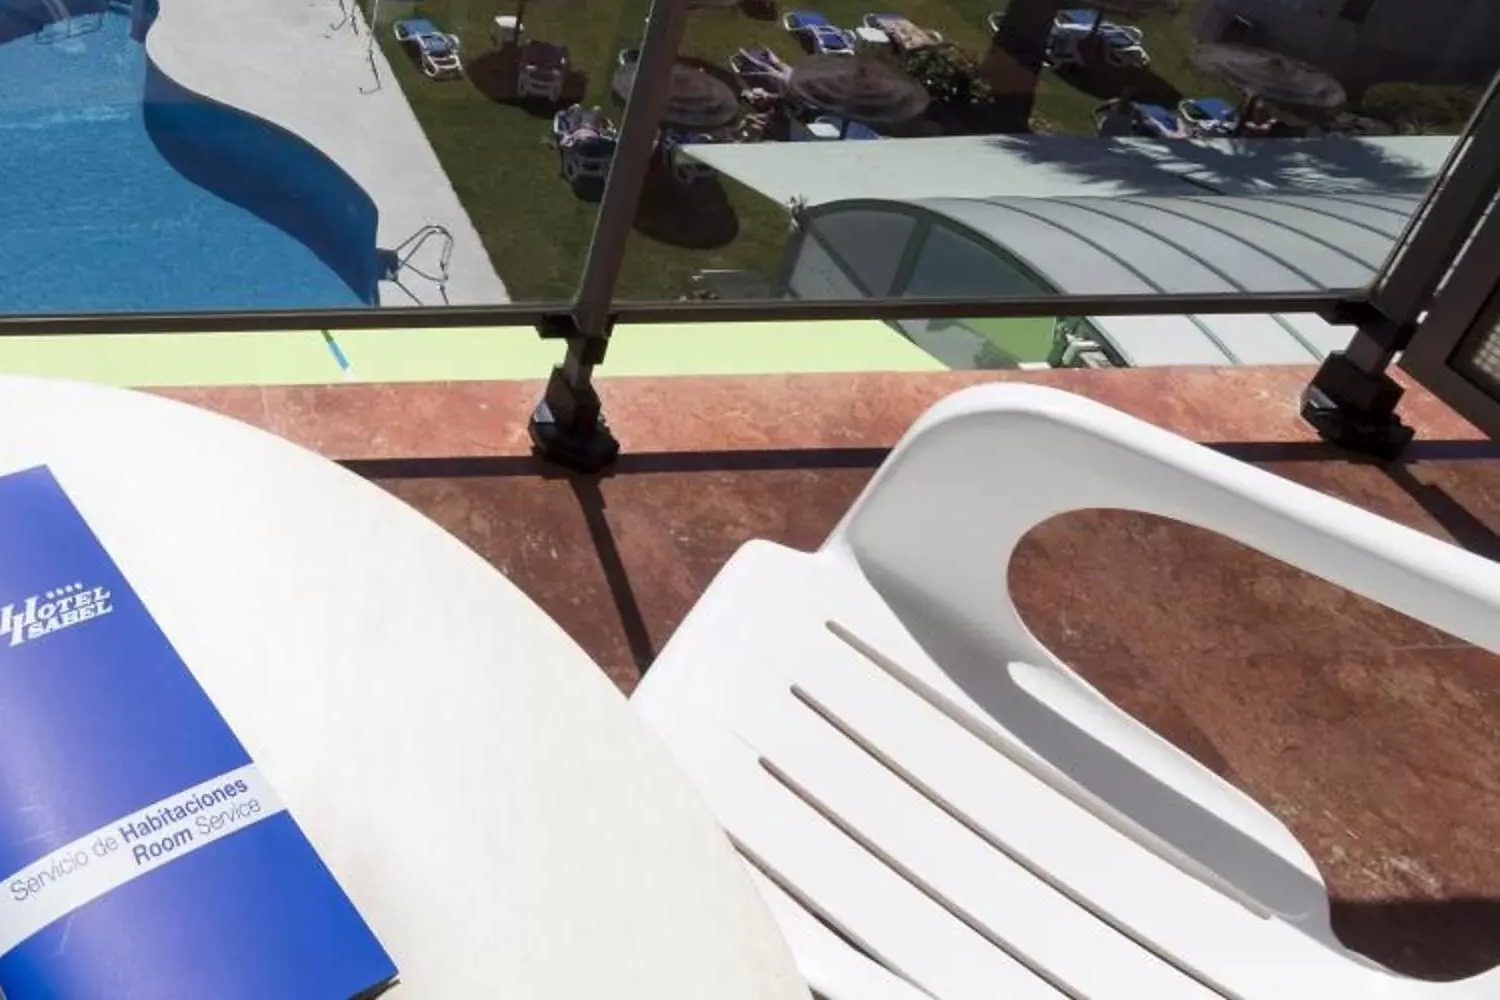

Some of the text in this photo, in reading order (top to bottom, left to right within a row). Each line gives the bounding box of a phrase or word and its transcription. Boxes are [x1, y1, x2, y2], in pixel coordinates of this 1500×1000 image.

[9, 601, 113, 647] ISABEL
[9, 777, 249, 902] Servicio de Habitaciones
[132, 798, 262, 866] Room Service
